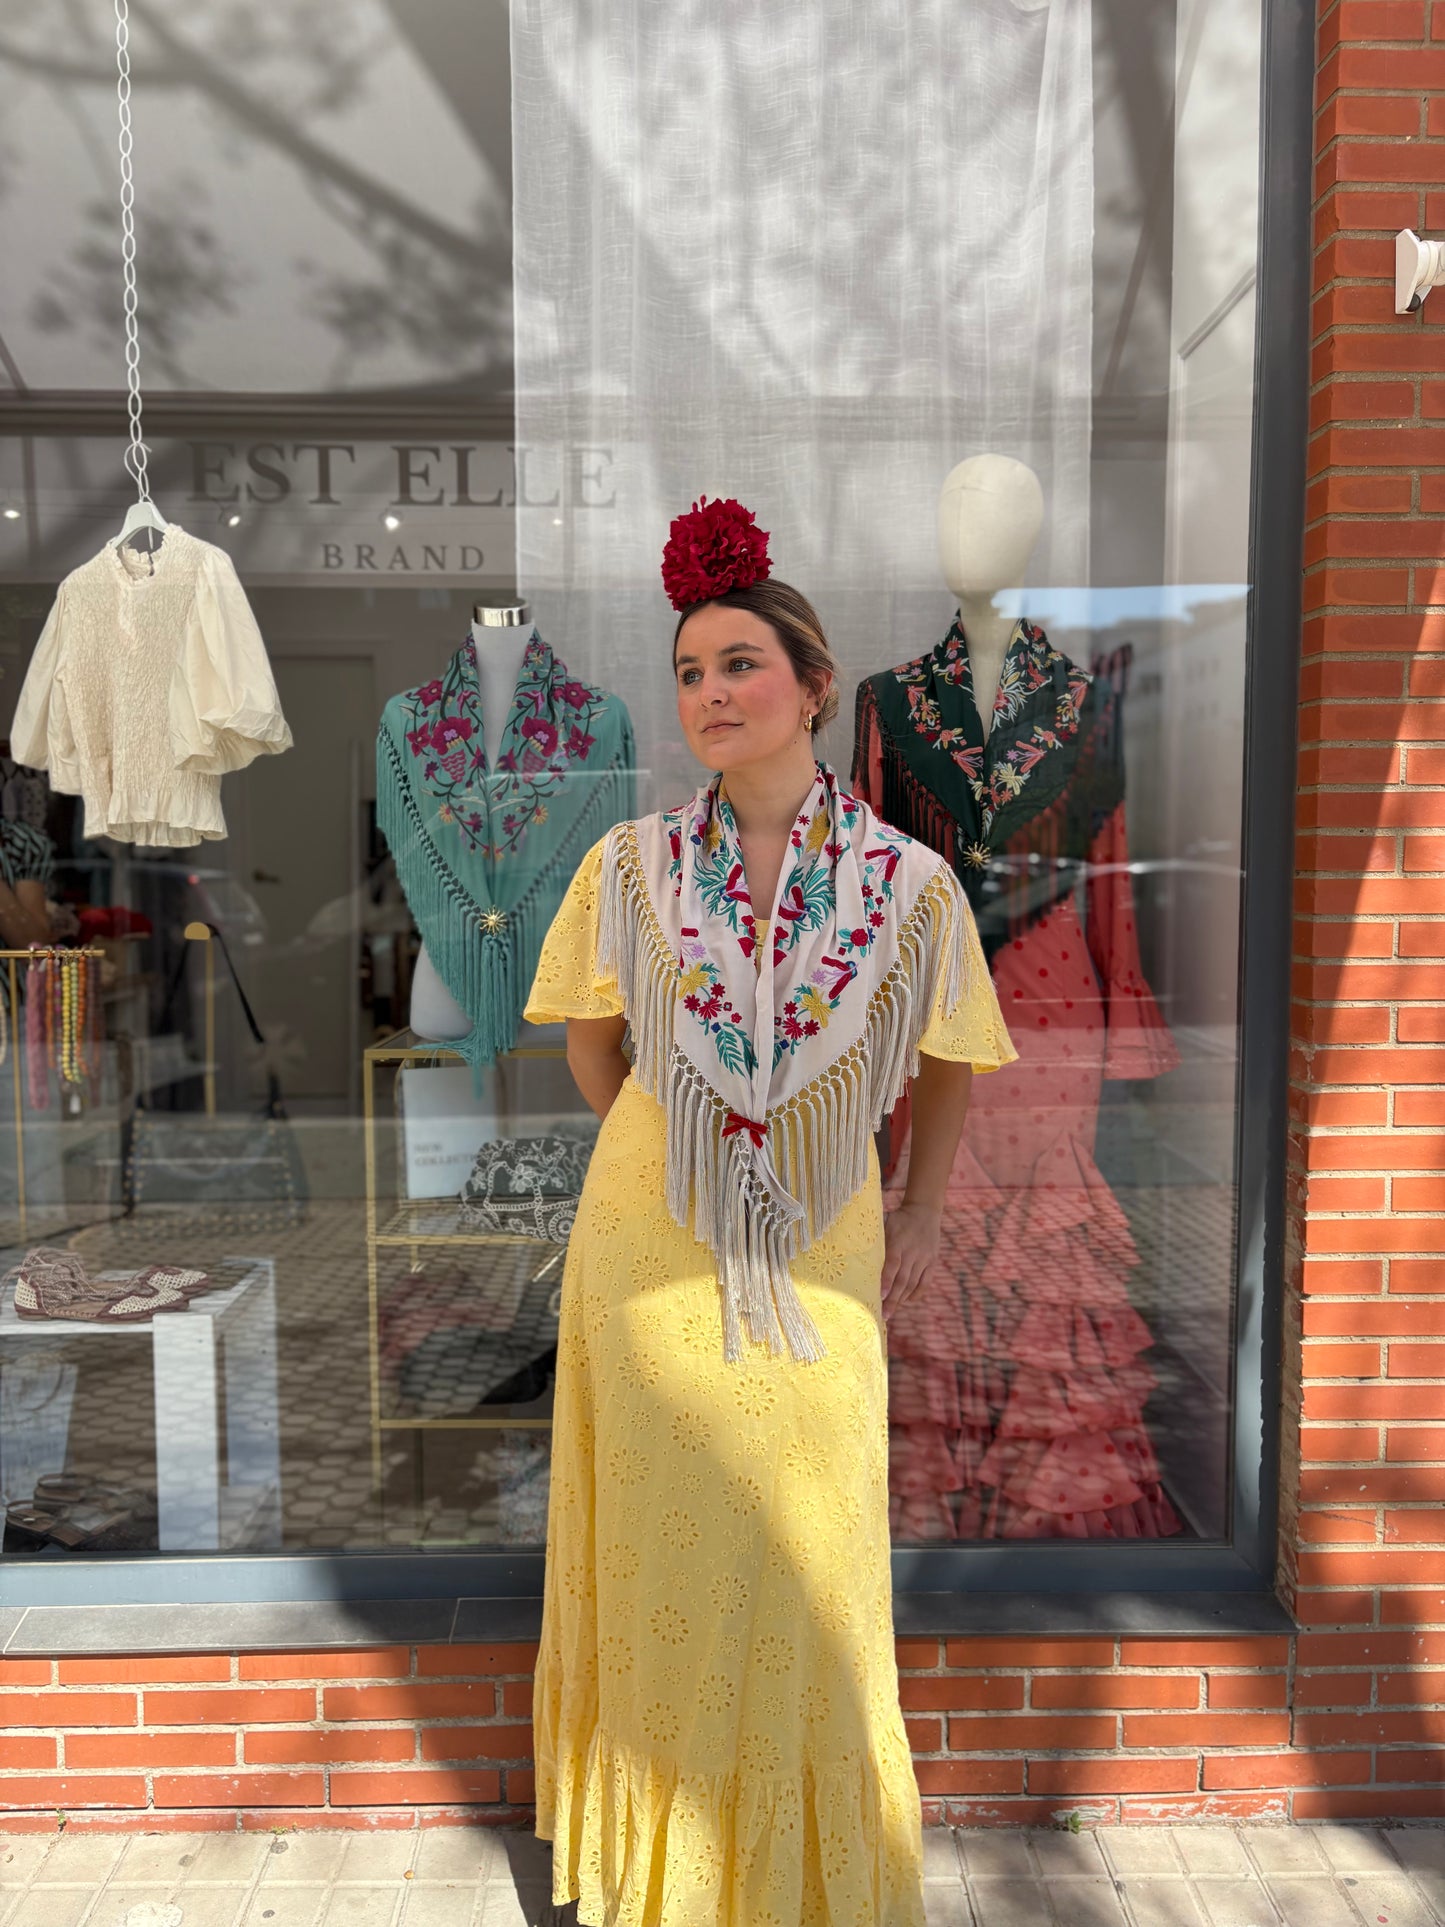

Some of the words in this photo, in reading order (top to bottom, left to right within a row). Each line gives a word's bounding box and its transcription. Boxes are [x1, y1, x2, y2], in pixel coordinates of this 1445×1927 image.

[186, 441, 355, 505] EST
[389, 445, 617, 508] ELLE
[322, 543, 485, 571] BRAND
